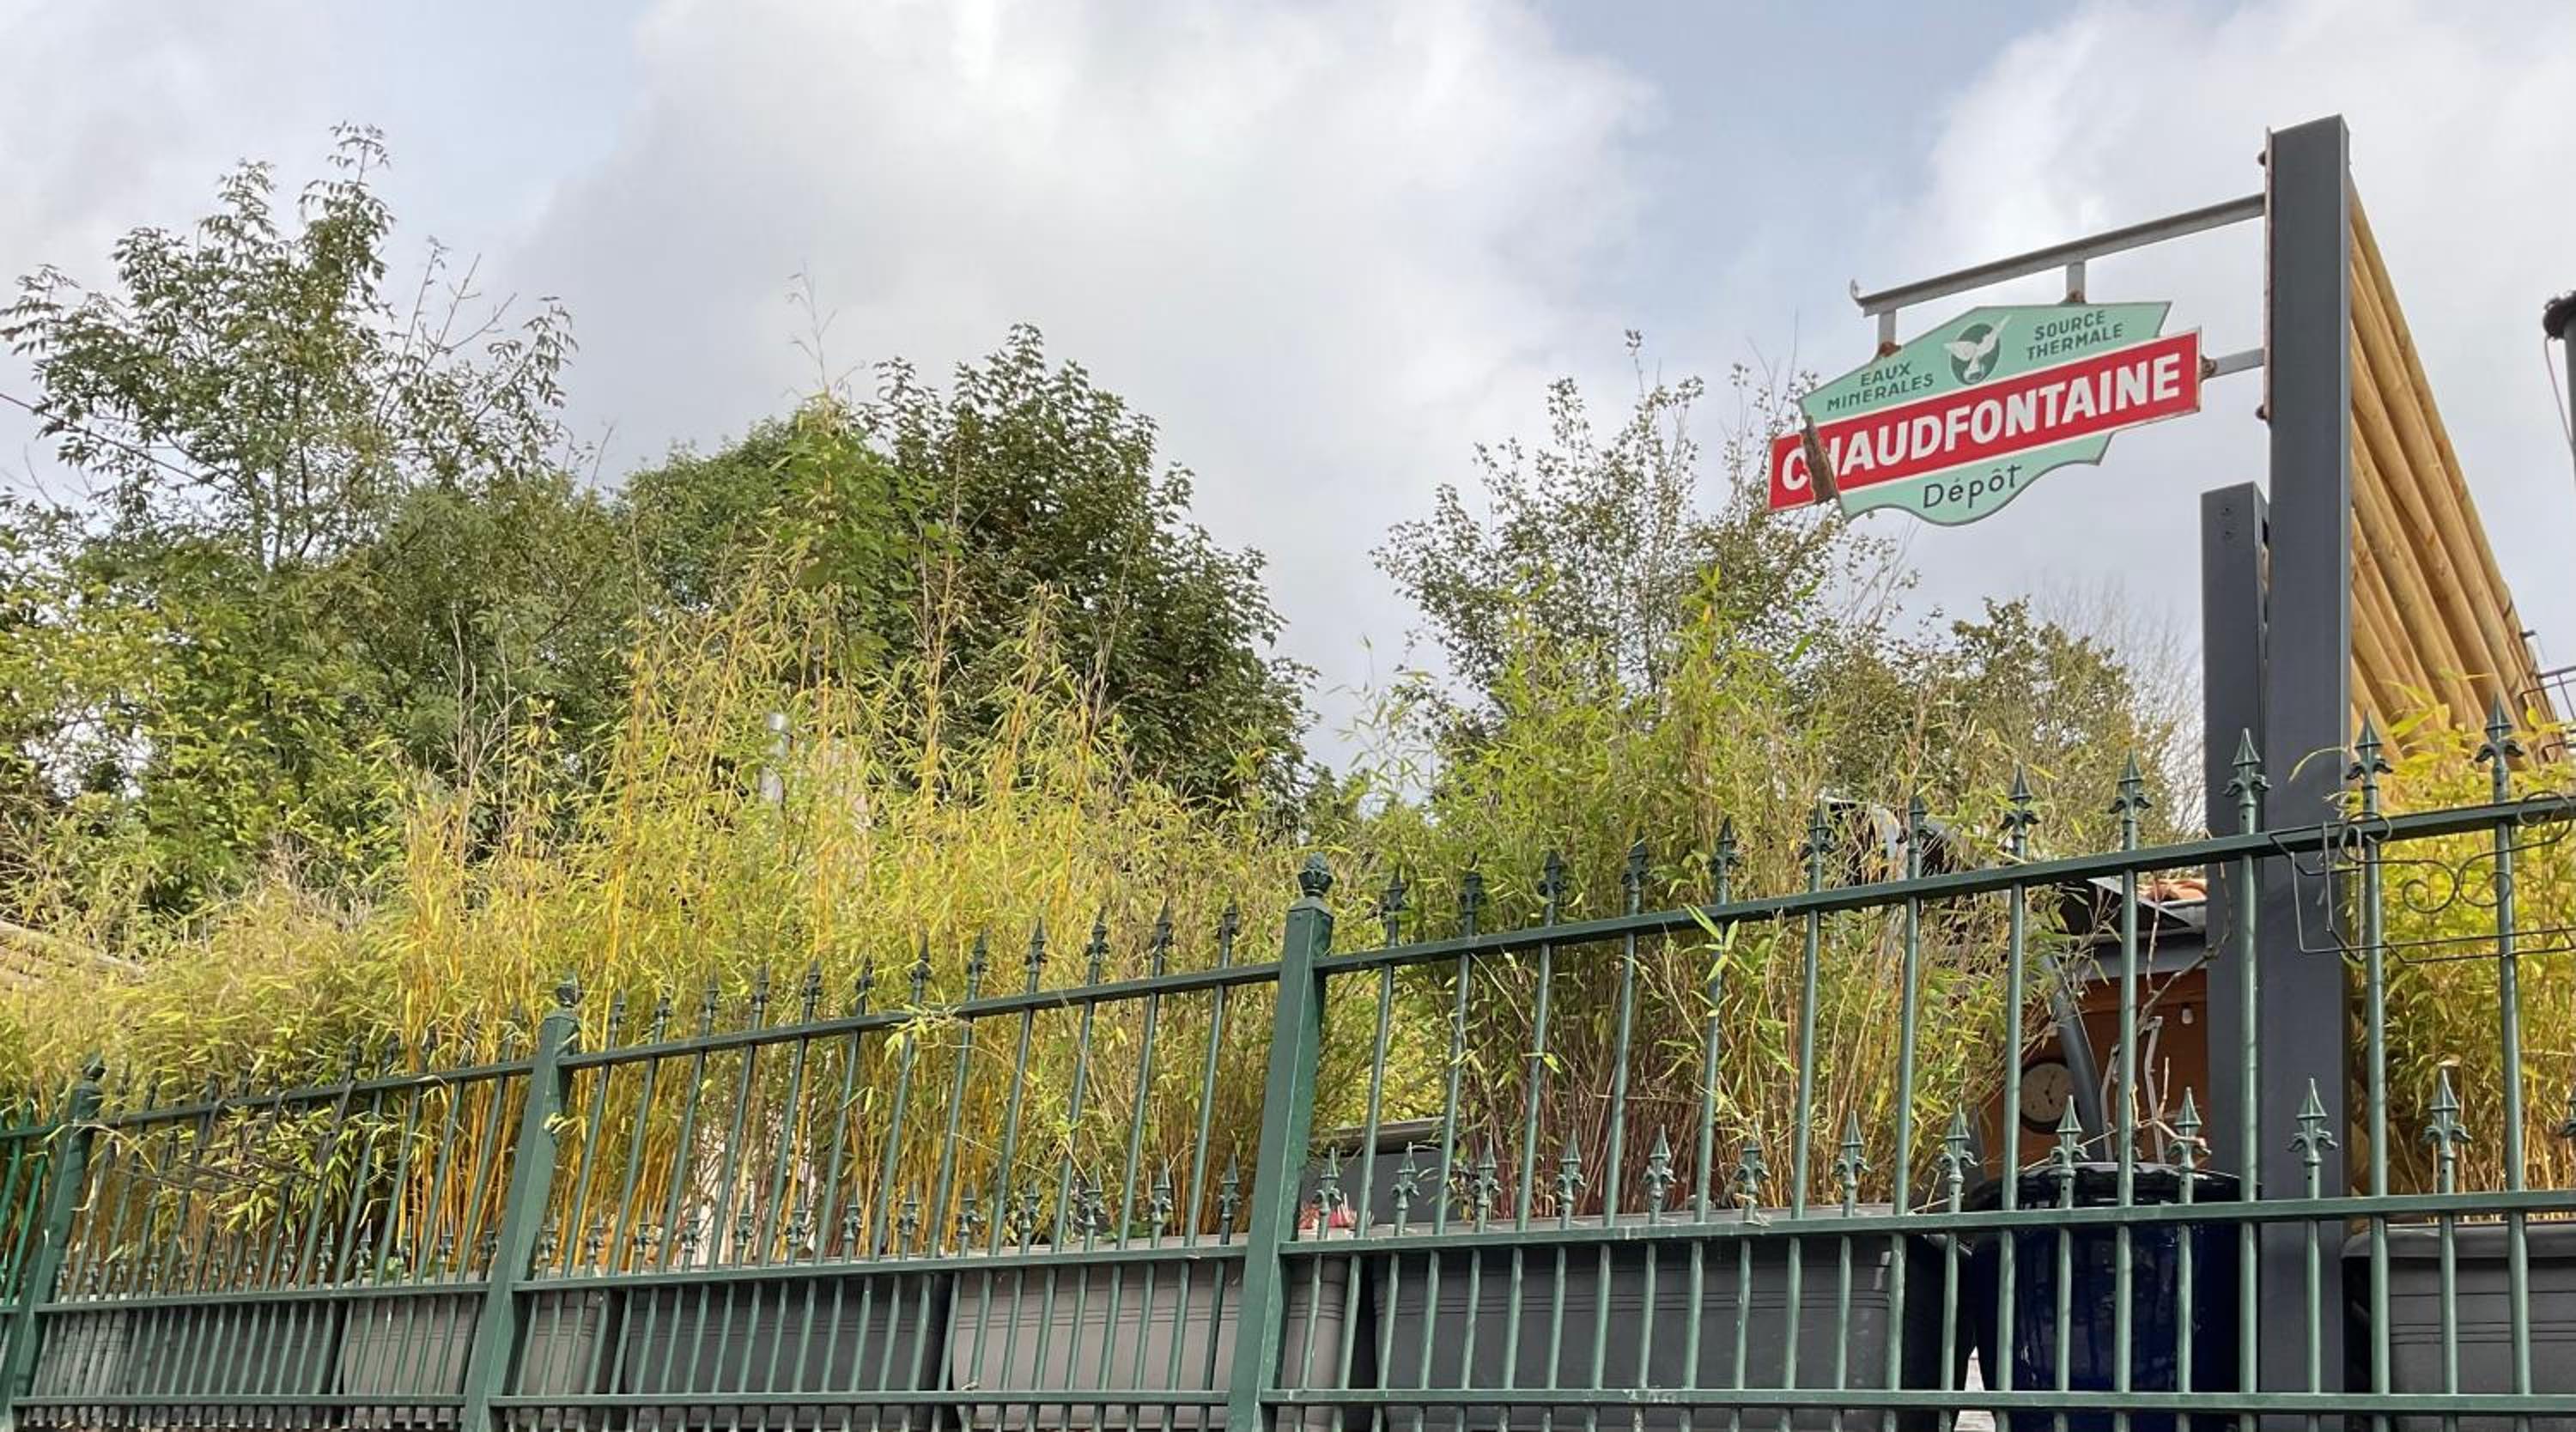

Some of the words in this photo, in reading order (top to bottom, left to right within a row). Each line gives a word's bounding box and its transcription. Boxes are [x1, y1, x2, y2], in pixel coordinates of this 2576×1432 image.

[2026, 323, 2123, 361] THERMALE
[2034, 310, 2105, 341] SOURCE
[1826, 373, 1934, 411] MINERALES
[1860, 361, 1911, 387] EAUX
[1923, 464, 2022, 509] Dépôt
